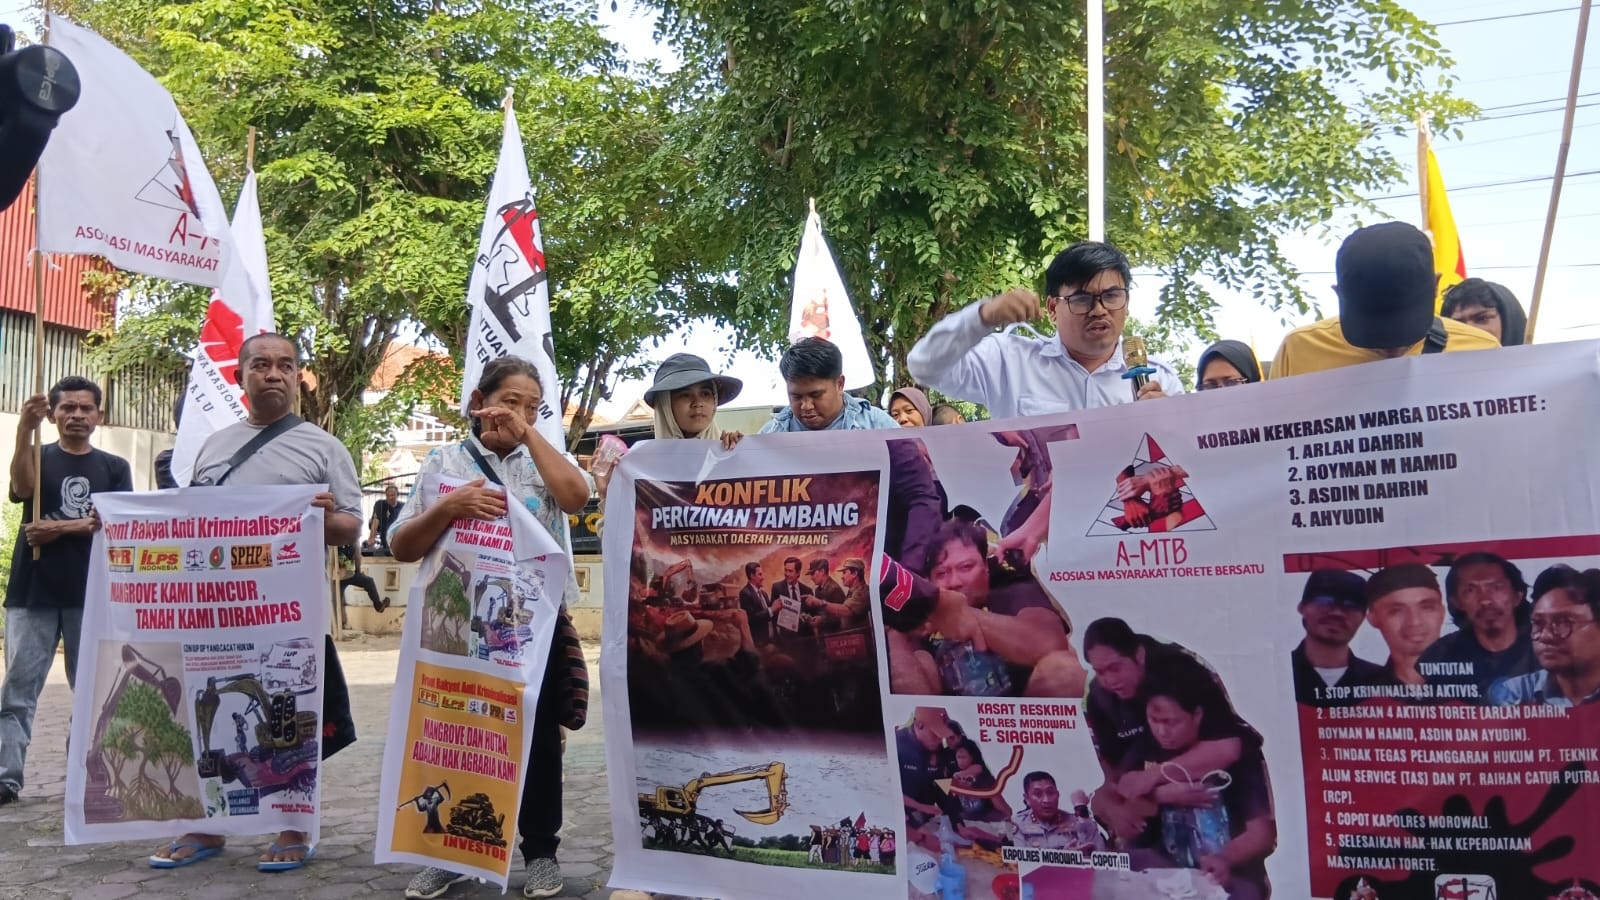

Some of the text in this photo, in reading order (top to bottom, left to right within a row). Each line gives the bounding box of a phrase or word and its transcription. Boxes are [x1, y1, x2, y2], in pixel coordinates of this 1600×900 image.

[134, 242, 218, 271] MASYARAKAT
[1197, 428, 1261, 450] KORBAN
[1263, 415, 1356, 442] KEKERASAN
[1358, 407, 1424, 430] WARGA
[1425, 402, 1472, 422] DESA
[1473, 395, 1538, 418] TORETE
[1287, 431, 1424, 461] 1. ARLAN DAHRIN
[1288, 452, 1458, 482] 2. ROYMAN M HAMID
[694, 478, 812, 505] KONFLIK
[1289, 479, 1429, 506] 3. ASDIN DAHRIN
[652, 502, 858, 529] PERIZINAN TAMBANG
[1292, 506, 1385, 528] 4. AHYUDIN
[130, 519, 169, 541] Rakyat
[171, 517, 195, 539] Anti
[199, 514, 302, 538] Kriminalisasi
[455, 531, 479, 546] TANAH
[479, 535, 502, 550] KAMI
[670, 534, 829, 546] MASYARAKAT DAERAH TAMBANG
[1116, 538, 1189, 567] A-MTB
[1050, 564, 1265, 582] ASOSIASI MASYARAKAT TORETE BERSATU
[160, 582, 193, 603] KAMI
[196, 580, 259, 603] HANCUR
[136, 602, 301, 630] TANAH KAMI DIRAMPAS
[1419, 661, 1475, 677] TUNTUTAN
[1326, 685, 1351, 699] STOP
[1353, 683, 1434, 699] KRIMINALISASI
[1436, 683, 1483, 698] AKTIVIS.
[977, 703, 1077, 717] KASAT RESKRIM
[1330, 705, 1384, 720] BEBASKAN
[1387, 705, 1395, 719] 4
[1396, 705, 1437, 720] AKTIVIS
[1438, 705, 1478, 720] TORETE
[424, 718, 466, 746] MANGROVE
[466, 726, 483, 749] DAN
[978, 717, 1076, 730] POLRES MOROWALI
[980, 729, 1055, 745] E. SIAGIAN
[1318, 727, 1364, 741] ROYMAN
[1366, 727, 1377, 741] M
[1379, 727, 1418, 743] HAMID,
[1420, 727, 1454, 742] ASDIN
[1455, 727, 1479, 743] DAN
[413, 740, 517, 784] ADALAH HAK AGRARIA KAMI
[1333, 747, 1373, 762] TINDAK
[1375, 748, 1407, 763] TEGAS
[1411, 748, 1490, 765] PELANGGARAN
[1493, 748, 1535, 764] HUKUM
[1558, 747, 1599, 763] TEKNIK
[1322, 768, 1351, 782] ALUM
[1354, 770, 1398, 785] SERVICE
[1432, 771, 1456, 786] DAN
[1479, 771, 1522, 786] RAIHAN
[1524, 770, 1561, 785] CATUR
[1324, 811, 1492, 830] 4. COPOT KAPOLRES MOROWALI.
[443, 834, 506, 863] INVESTOR
[1326, 832, 1533, 852] 5. SELESAIKAN HAK-HAK KEPERDATAAN
[1003, 848, 1040, 863] KAPOLRES
[1327, 855, 1440, 872] MASYARAKAT TORETE.
